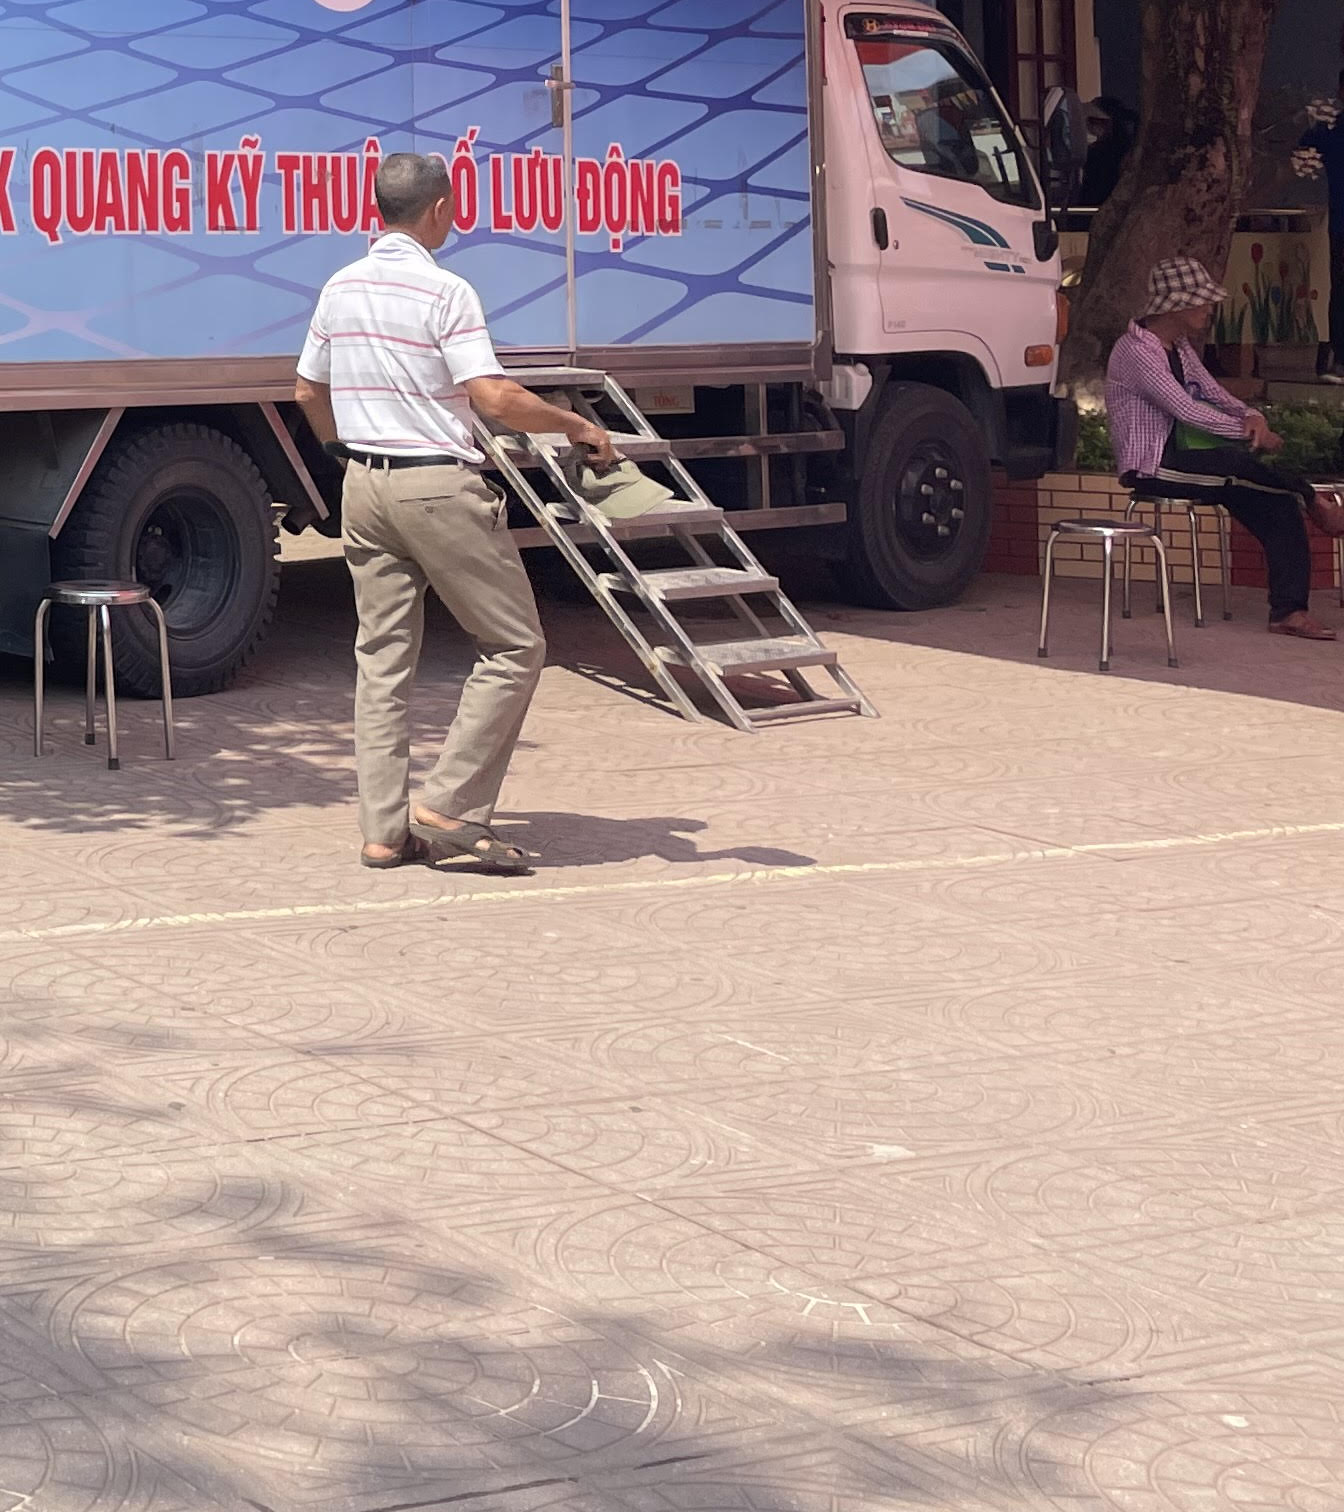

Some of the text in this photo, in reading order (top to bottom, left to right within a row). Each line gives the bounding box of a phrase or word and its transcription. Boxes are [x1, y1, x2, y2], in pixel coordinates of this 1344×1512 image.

[29, 145, 193, 246] QUANG
[205, 133, 265, 236] KỸ
[275, 136, 388, 250] THUẬ
[489, 146, 564, 234] LƯU
[573, 142, 683, 253] ĐỘNG
